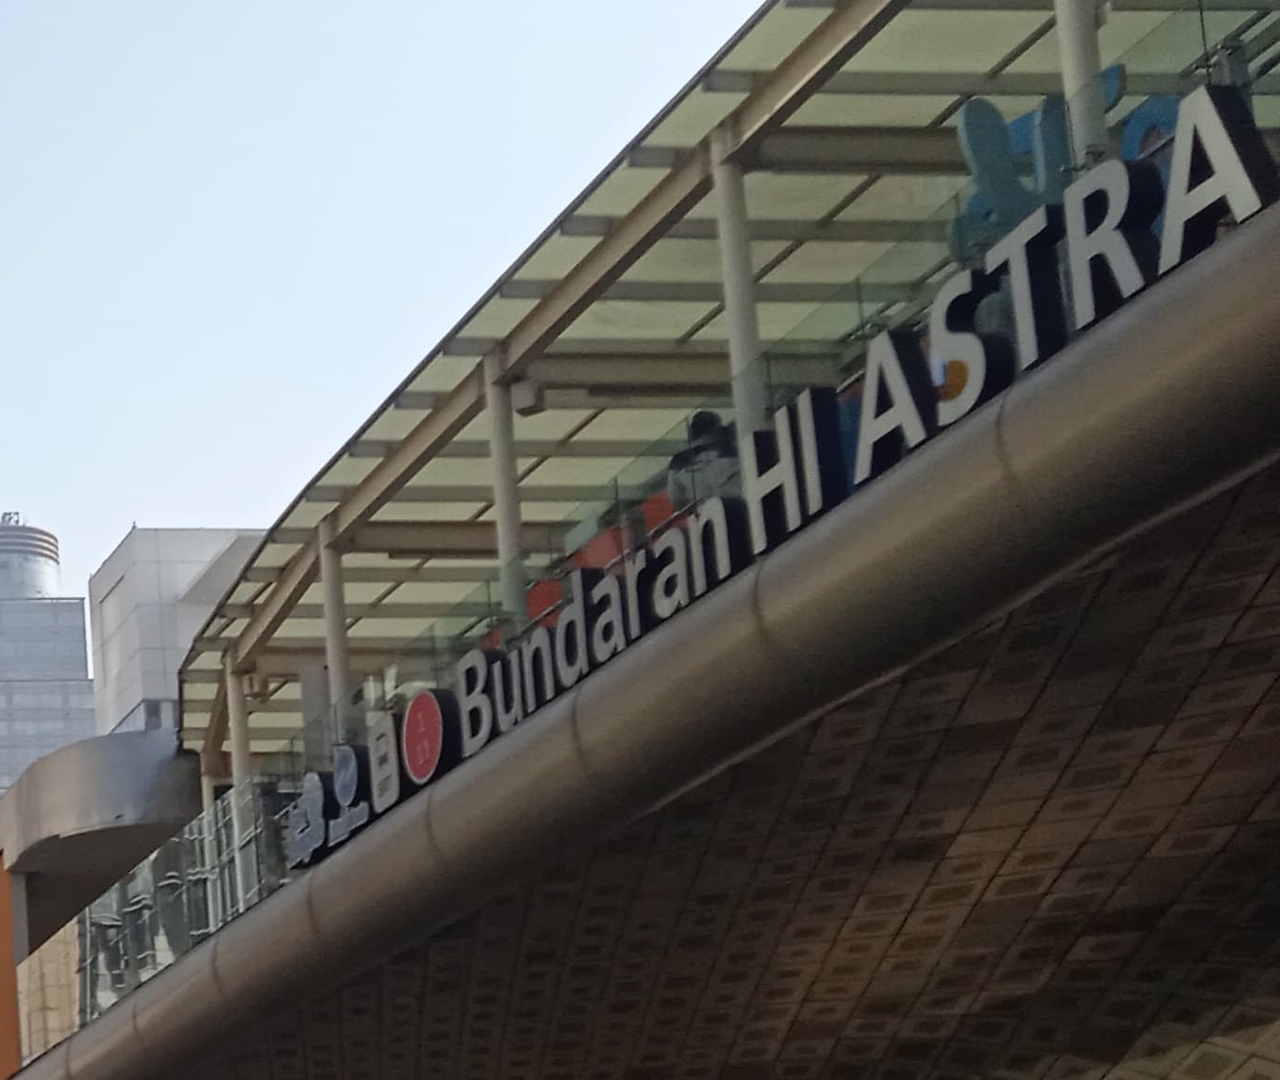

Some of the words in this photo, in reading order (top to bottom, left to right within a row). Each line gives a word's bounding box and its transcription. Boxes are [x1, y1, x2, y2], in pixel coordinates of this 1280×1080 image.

[457, 497, 730, 759] Bundaran
[741, 388, 824, 556] HI
[853, 84, 1262, 486] ASTRA
